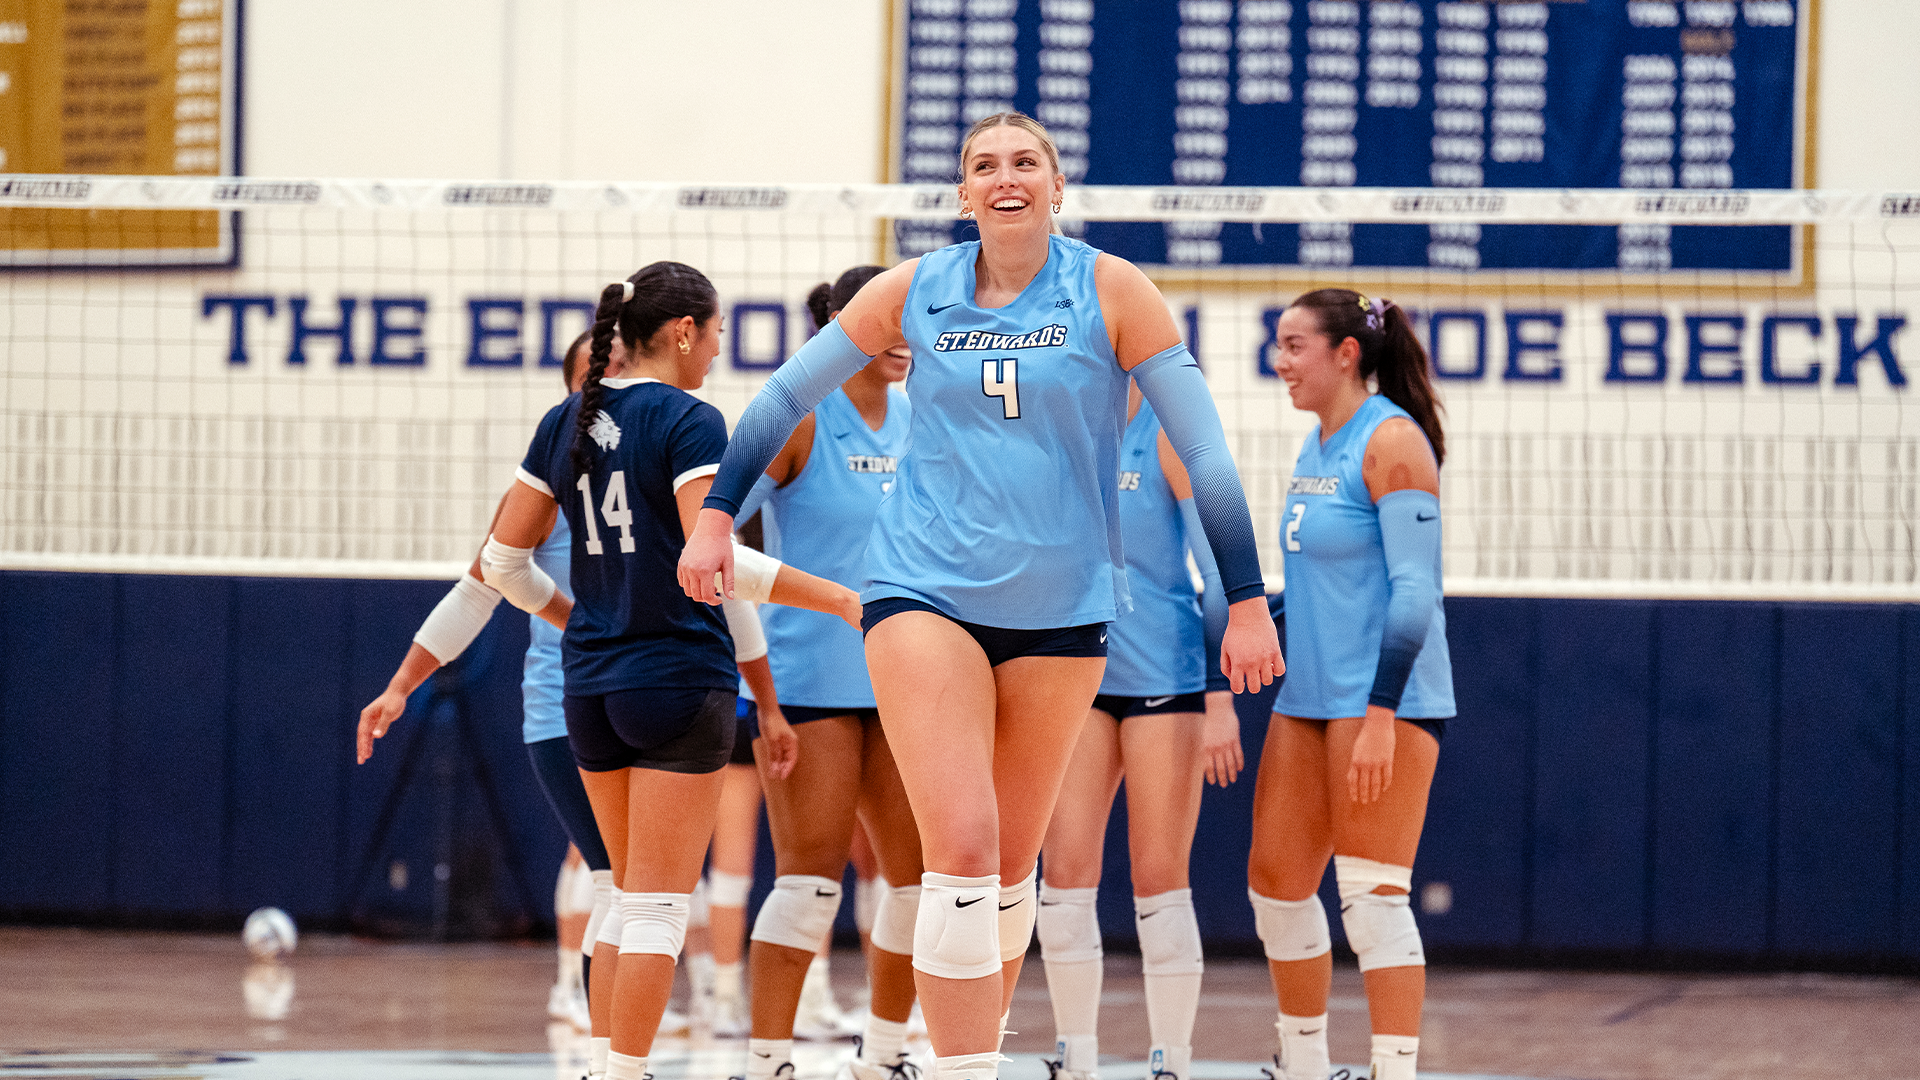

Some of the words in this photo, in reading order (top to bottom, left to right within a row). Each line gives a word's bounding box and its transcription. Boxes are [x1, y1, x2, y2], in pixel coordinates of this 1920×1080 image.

[201, 295, 429, 367] THE
[1604, 312, 1908, 386] BECK
[981, 358, 1021, 419] 4
[577, 471, 636, 555] 14
[1286, 502, 1305, 554] 2
